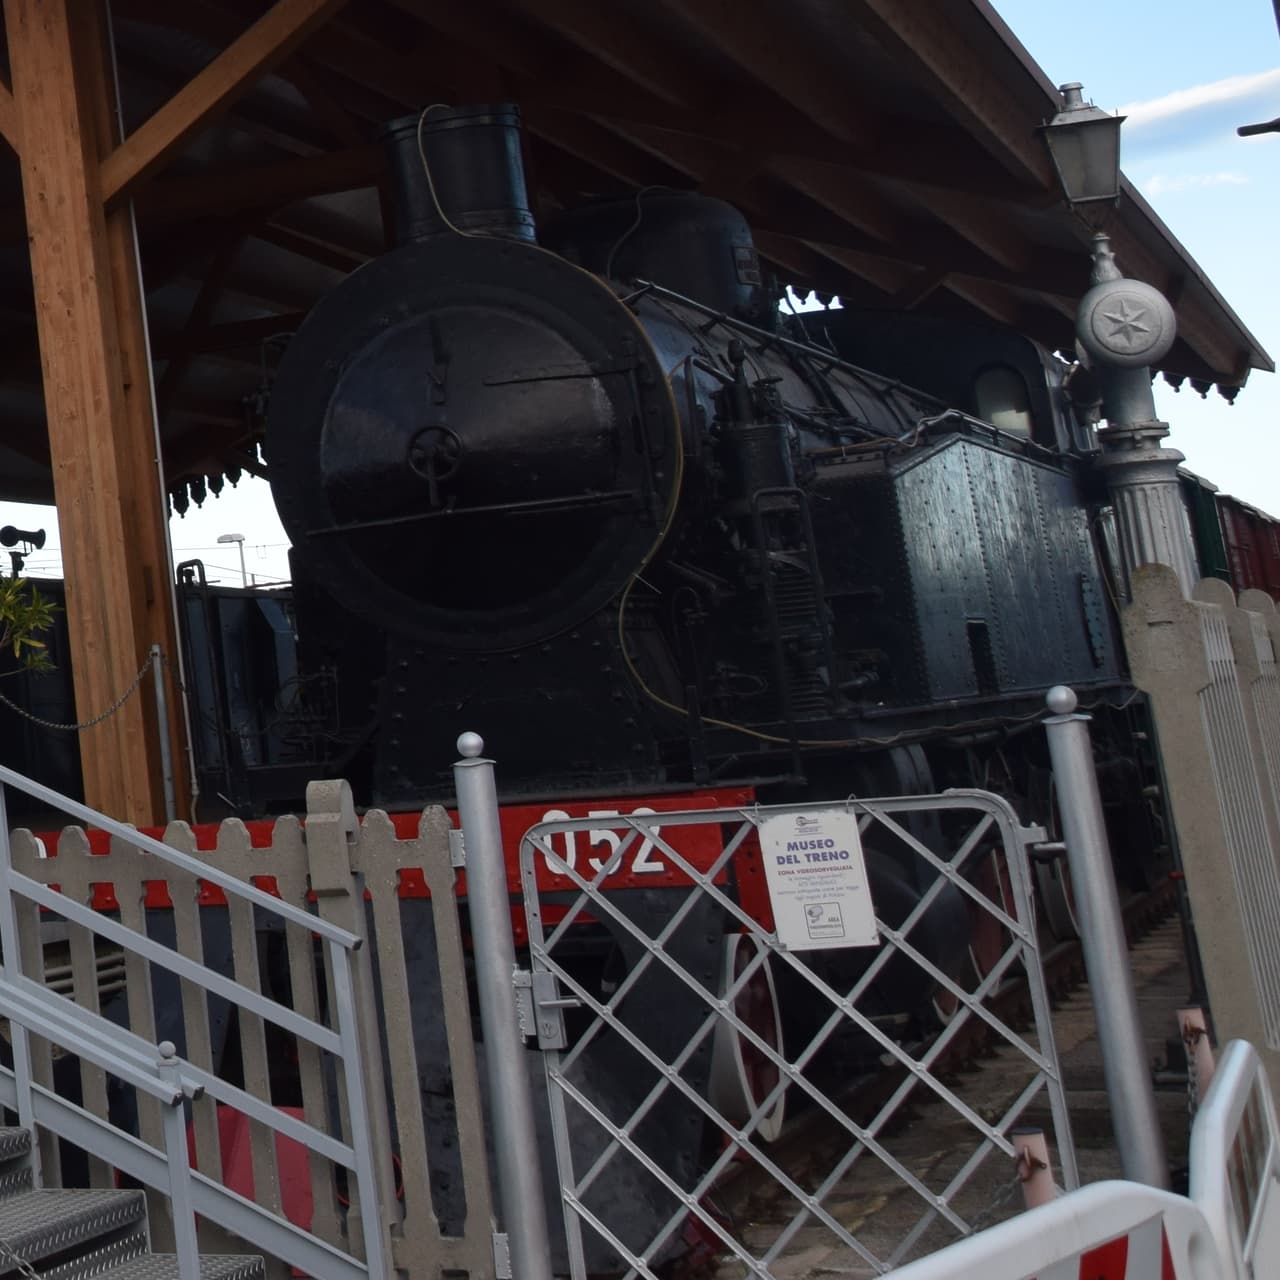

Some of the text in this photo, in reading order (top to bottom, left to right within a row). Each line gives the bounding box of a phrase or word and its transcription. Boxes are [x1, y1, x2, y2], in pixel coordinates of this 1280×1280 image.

[542, 807, 664, 875] 052
[787, 839, 834, 852] MUSEO
[776, 850, 849, 865] DEL TRENO
